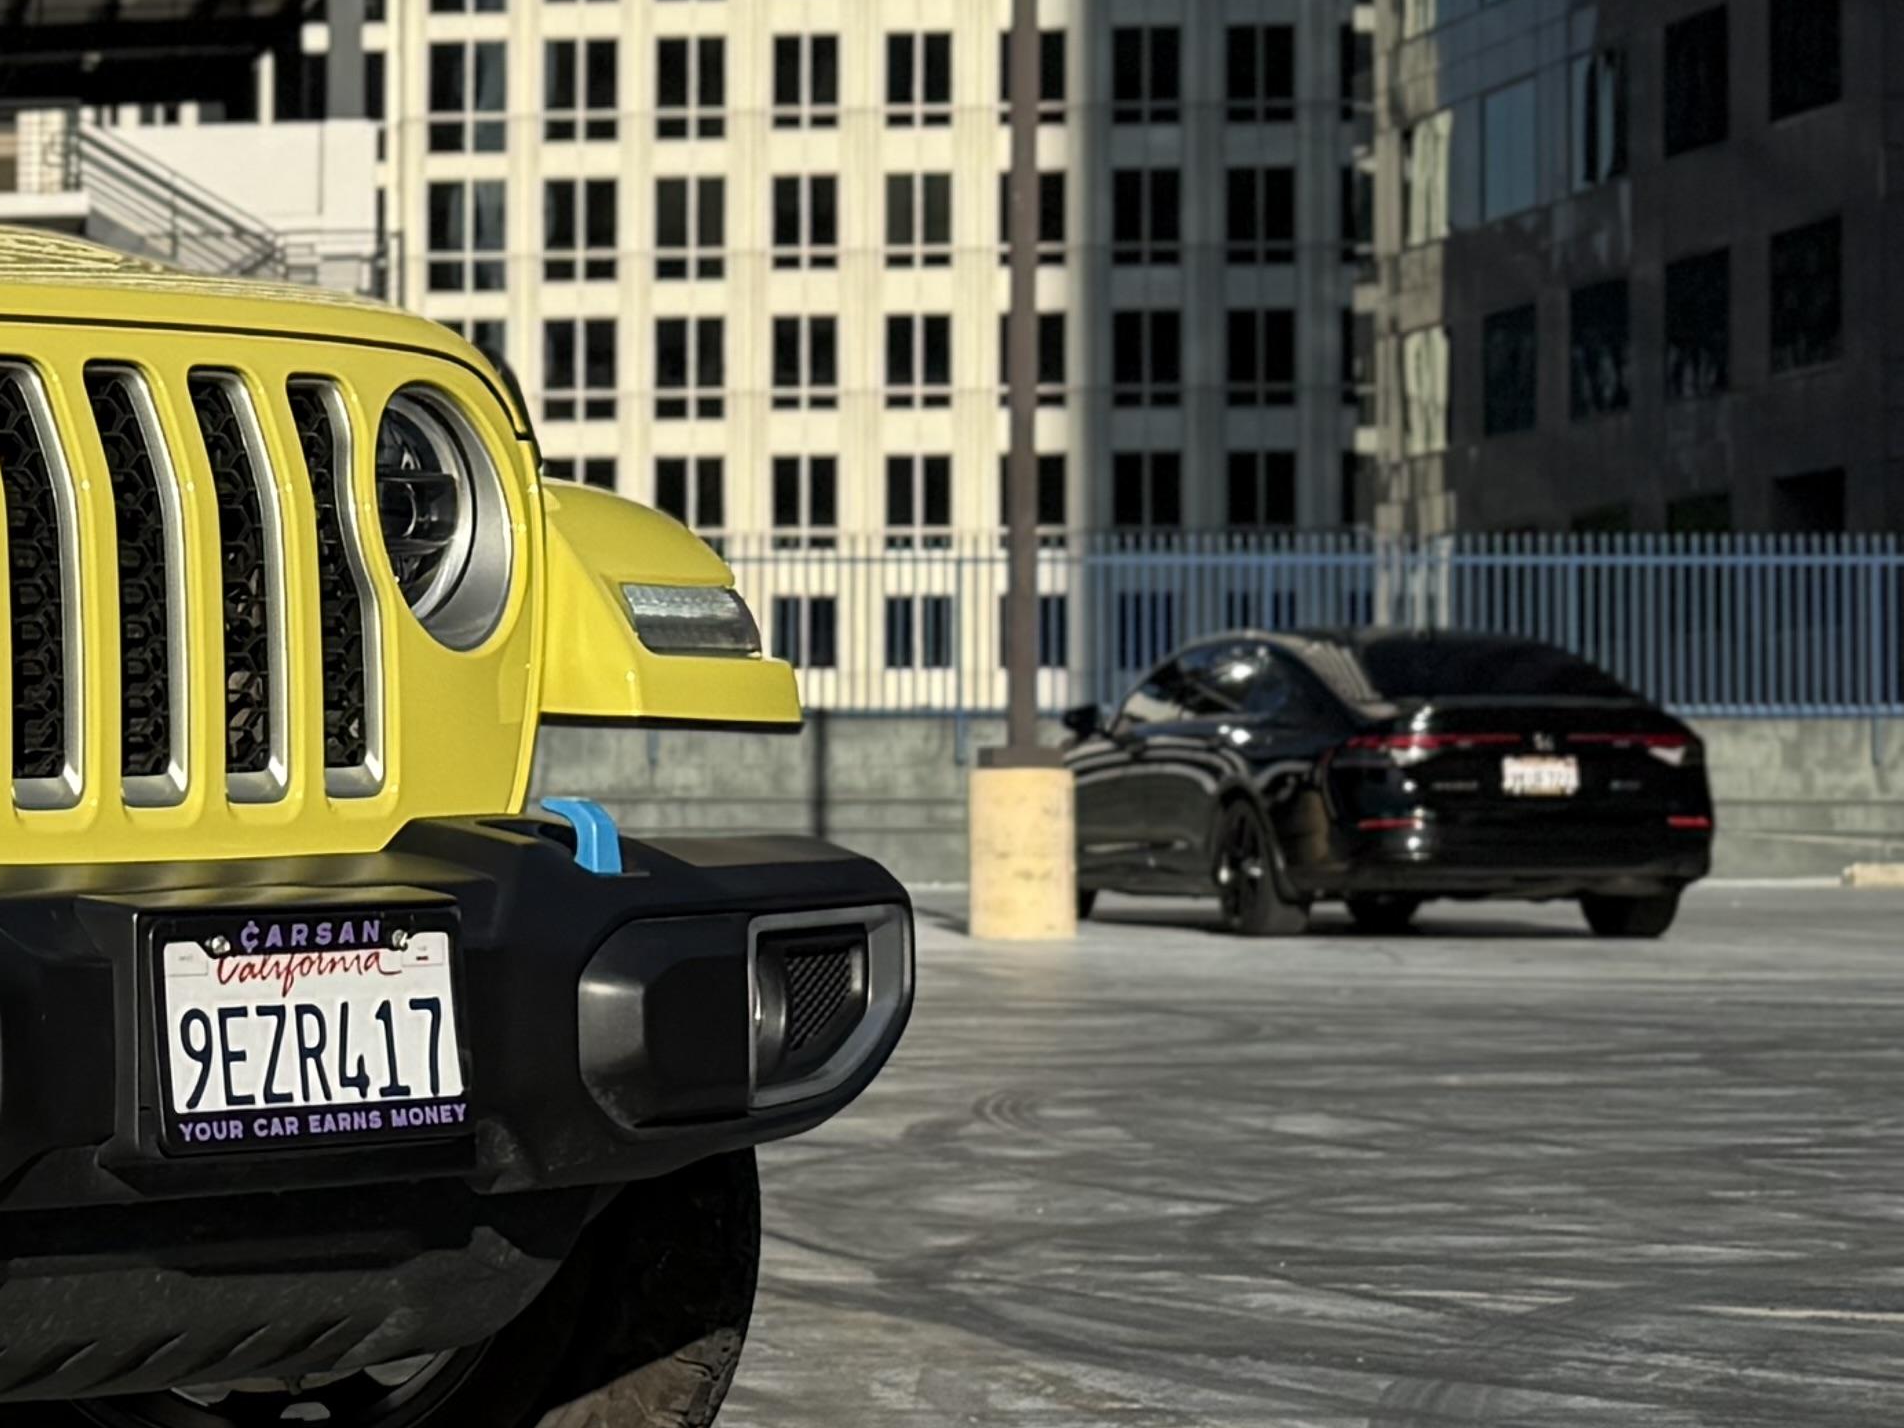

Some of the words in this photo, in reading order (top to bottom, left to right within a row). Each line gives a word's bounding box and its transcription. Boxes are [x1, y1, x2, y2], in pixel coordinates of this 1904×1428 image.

[217, 951, 402, 998] California
[180, 997, 442, 1109] 9EZR417
[179, 1120, 244, 1142] YOUR
[253, 1116, 299, 1137] CAR
[309, 1110, 383, 1133] EARNS
[391, 1103, 467, 1127] MONEY
